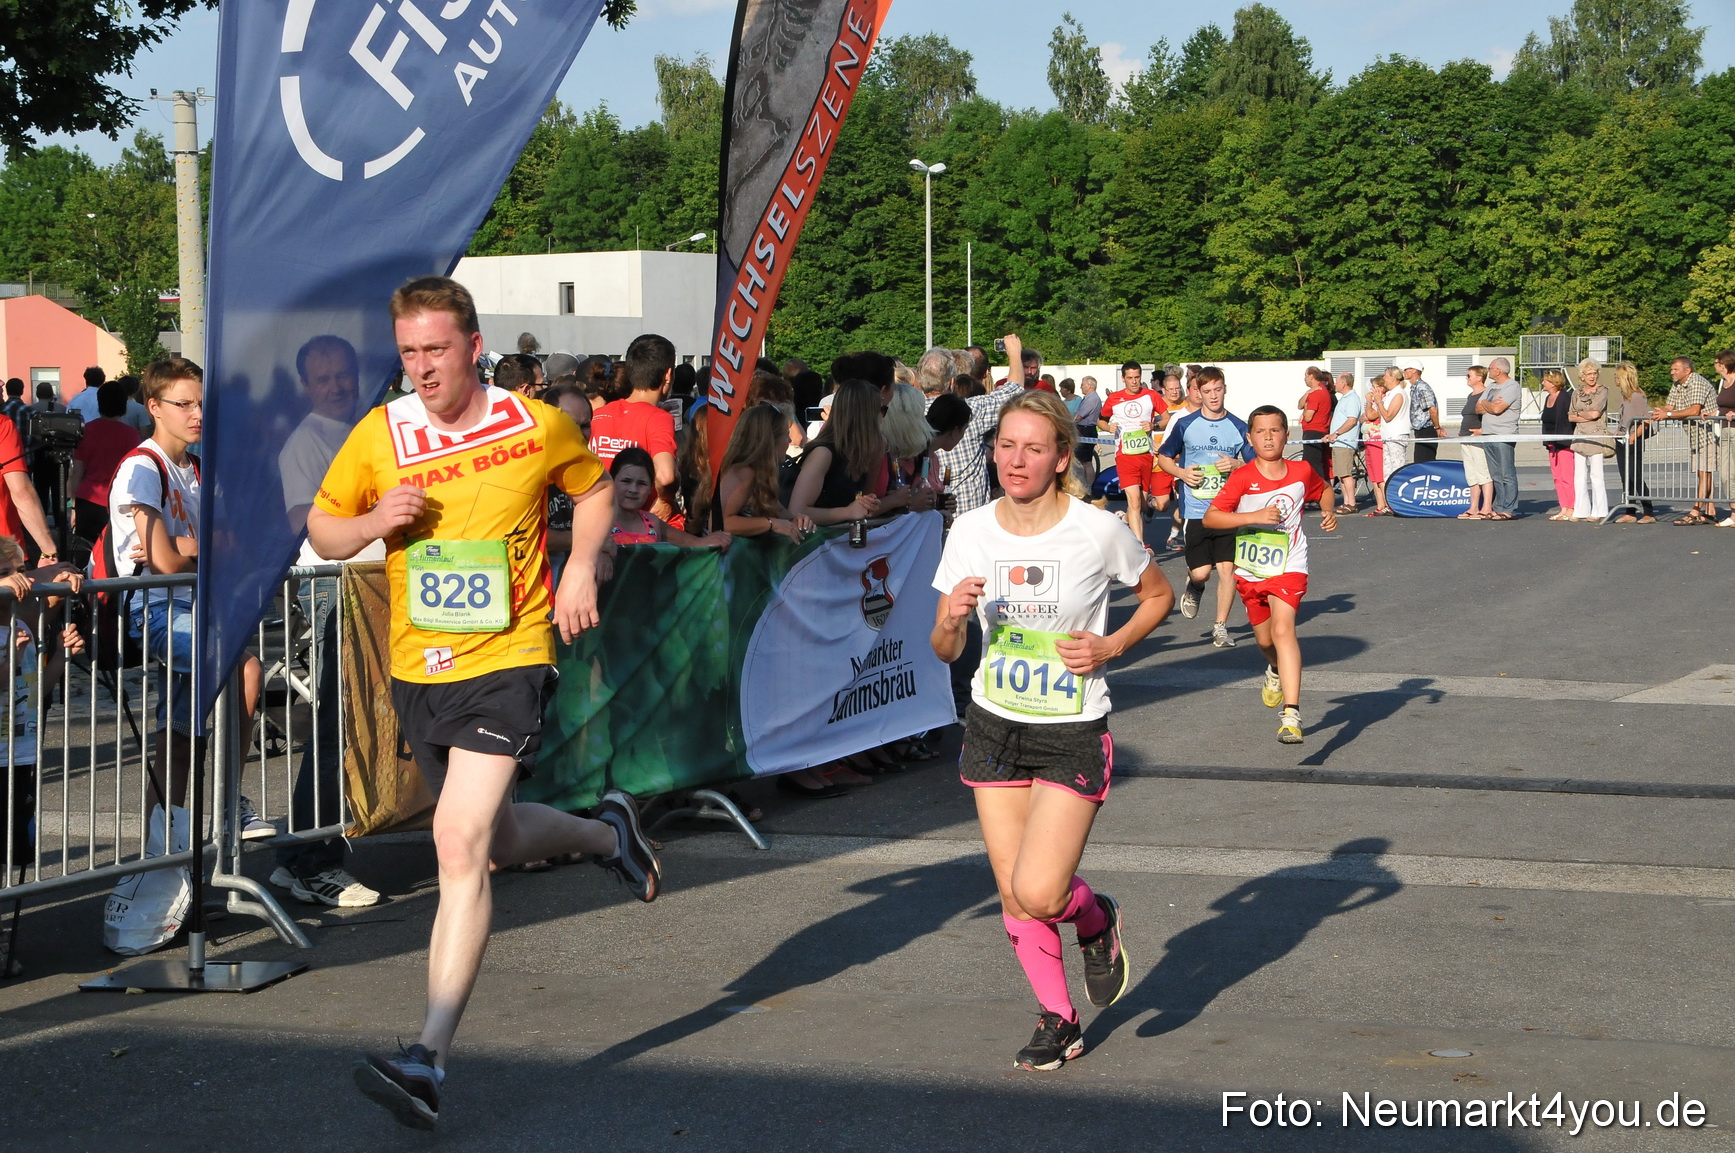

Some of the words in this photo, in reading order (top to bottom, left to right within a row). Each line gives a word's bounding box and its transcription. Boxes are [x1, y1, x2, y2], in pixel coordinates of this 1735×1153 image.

[453, 0, 528, 107] AUT
[708, 6, 873, 415] WECHSELSZENE
[399, 462, 465, 488] MAX
[472, 438, 543, 473] BÖGL
[1124, 436, 1148, 449] 1022
[1239, 541, 1283, 567] 1030
[420, 572, 491, 609] 828
[996, 604, 1058, 614] POLGER
[850, 638, 903, 681] Nmarkter
[989, 657, 1078, 699] 1014
